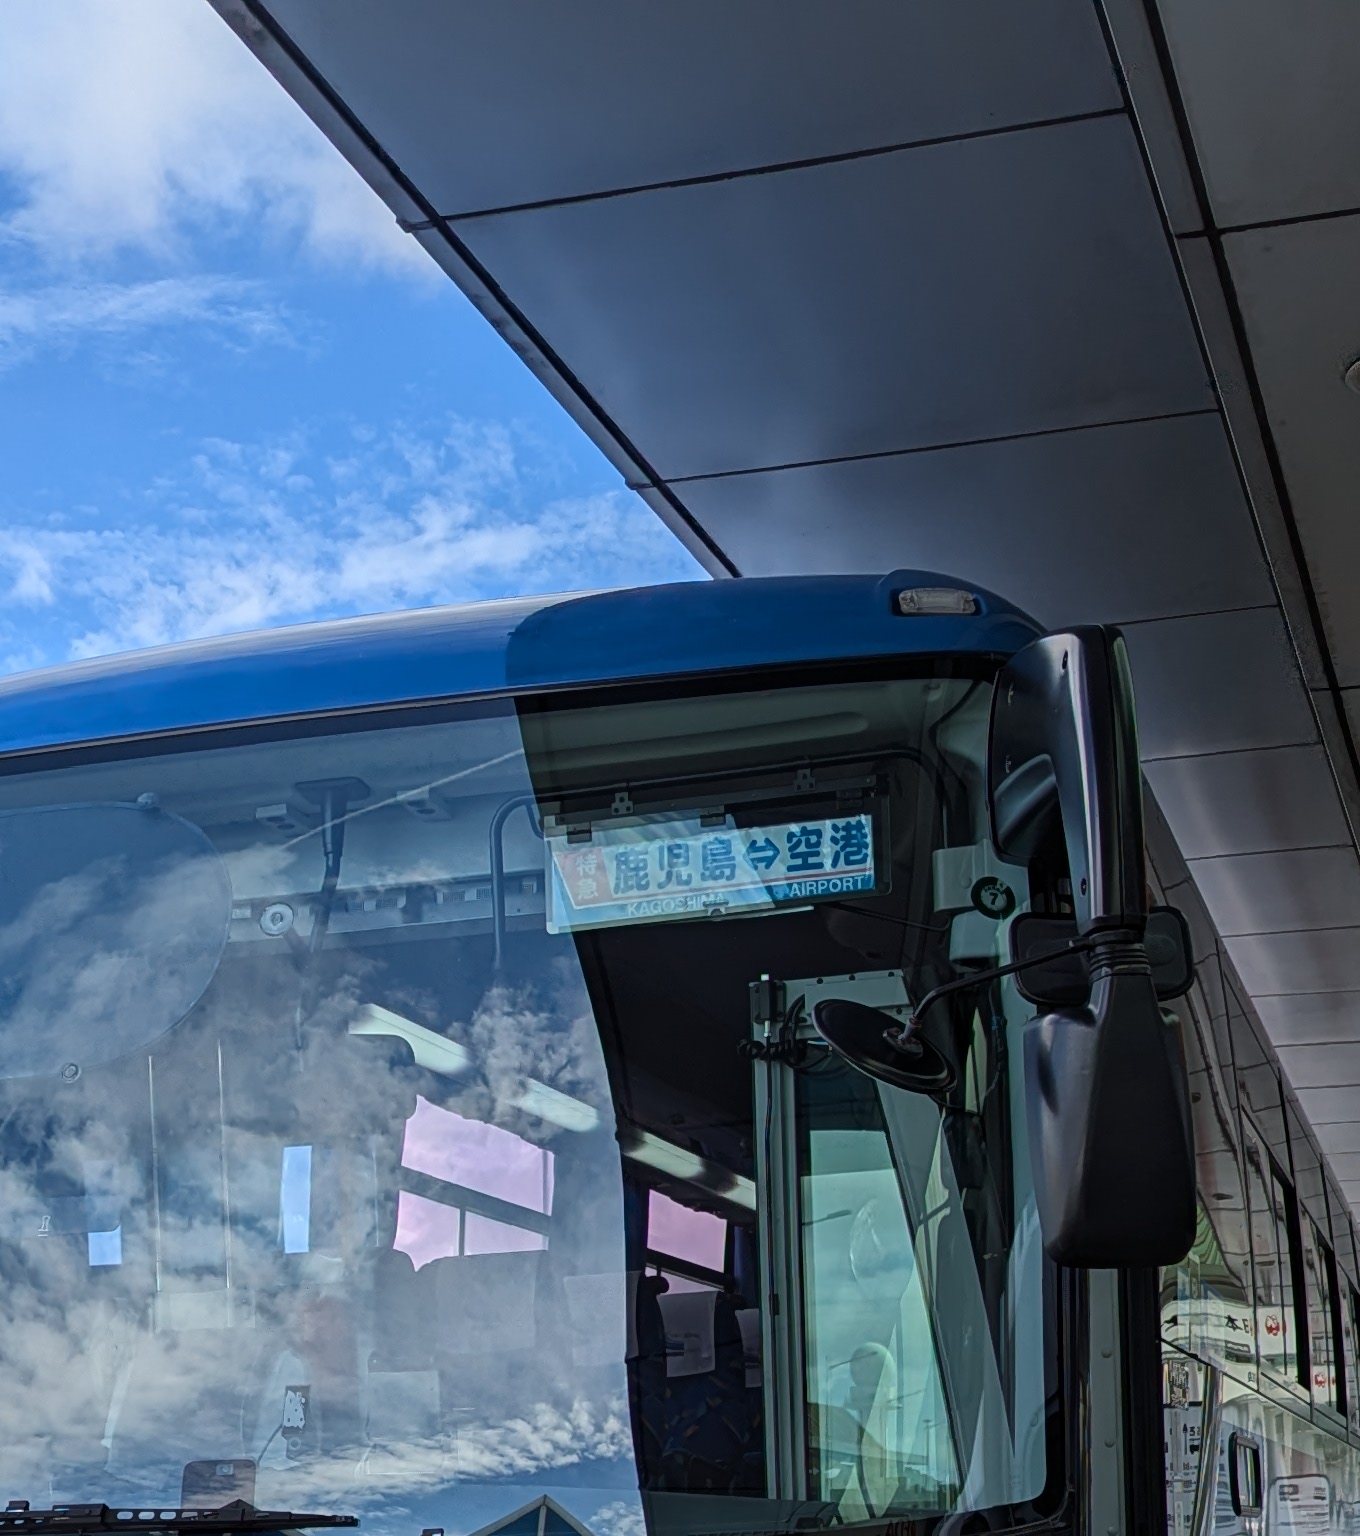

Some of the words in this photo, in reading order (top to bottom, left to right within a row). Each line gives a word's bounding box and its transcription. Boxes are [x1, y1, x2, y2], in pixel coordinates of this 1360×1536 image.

[575, 853, 600, 900] 特急
[613, 836, 737, 895] 鹿児島
[786, 819, 870, 873] 空港
[790, 875, 866, 899] AIRPORT
